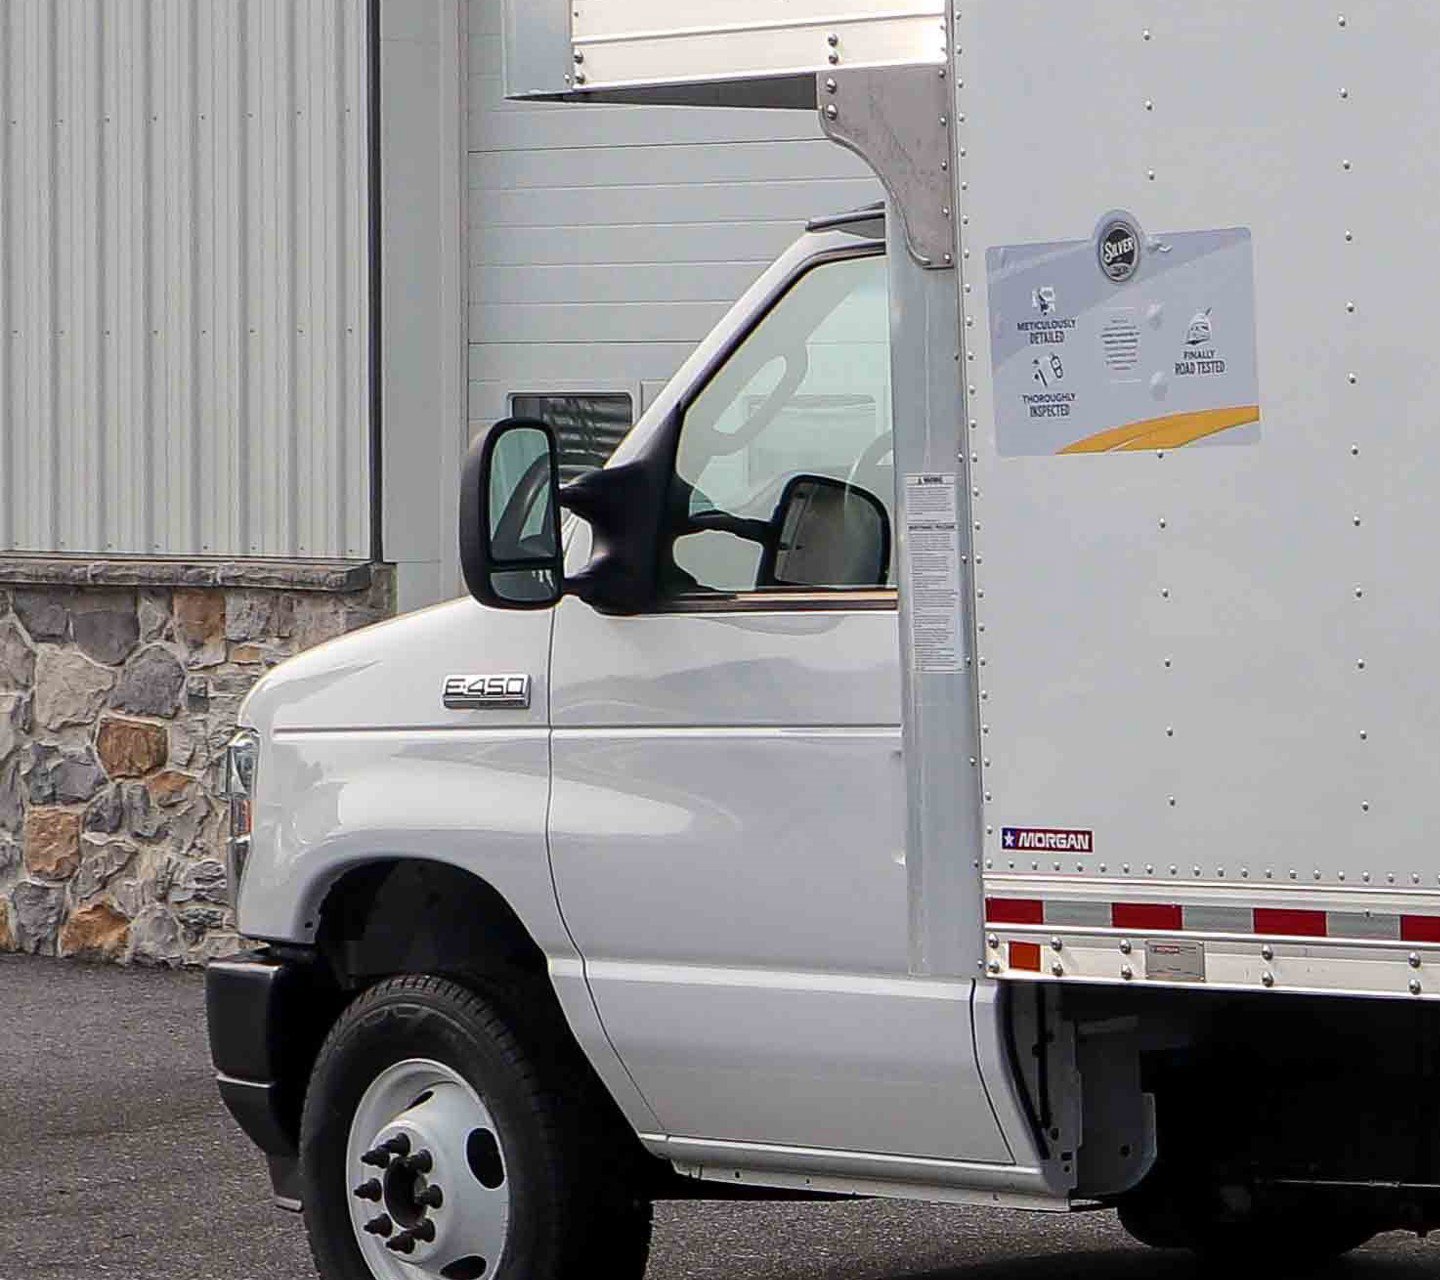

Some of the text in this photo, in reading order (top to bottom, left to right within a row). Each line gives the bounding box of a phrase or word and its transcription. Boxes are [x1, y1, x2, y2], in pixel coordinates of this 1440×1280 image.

[1103, 236, 1135, 263] SILVER
[1016, 319, 1077, 331] METICULOUSLY
[1030, 330, 1065, 345] DETAILED
[1183, 349, 1215, 360] FINALLY
[1174, 360, 1226, 376] ROAD TESTED
[1022, 392, 1077, 405] THOROUGHLY
[1030, 404, 1071, 418] INSPECTED
[445, 677, 525, 697] E-450
[1018, 831, 1090, 850] MORGAN
